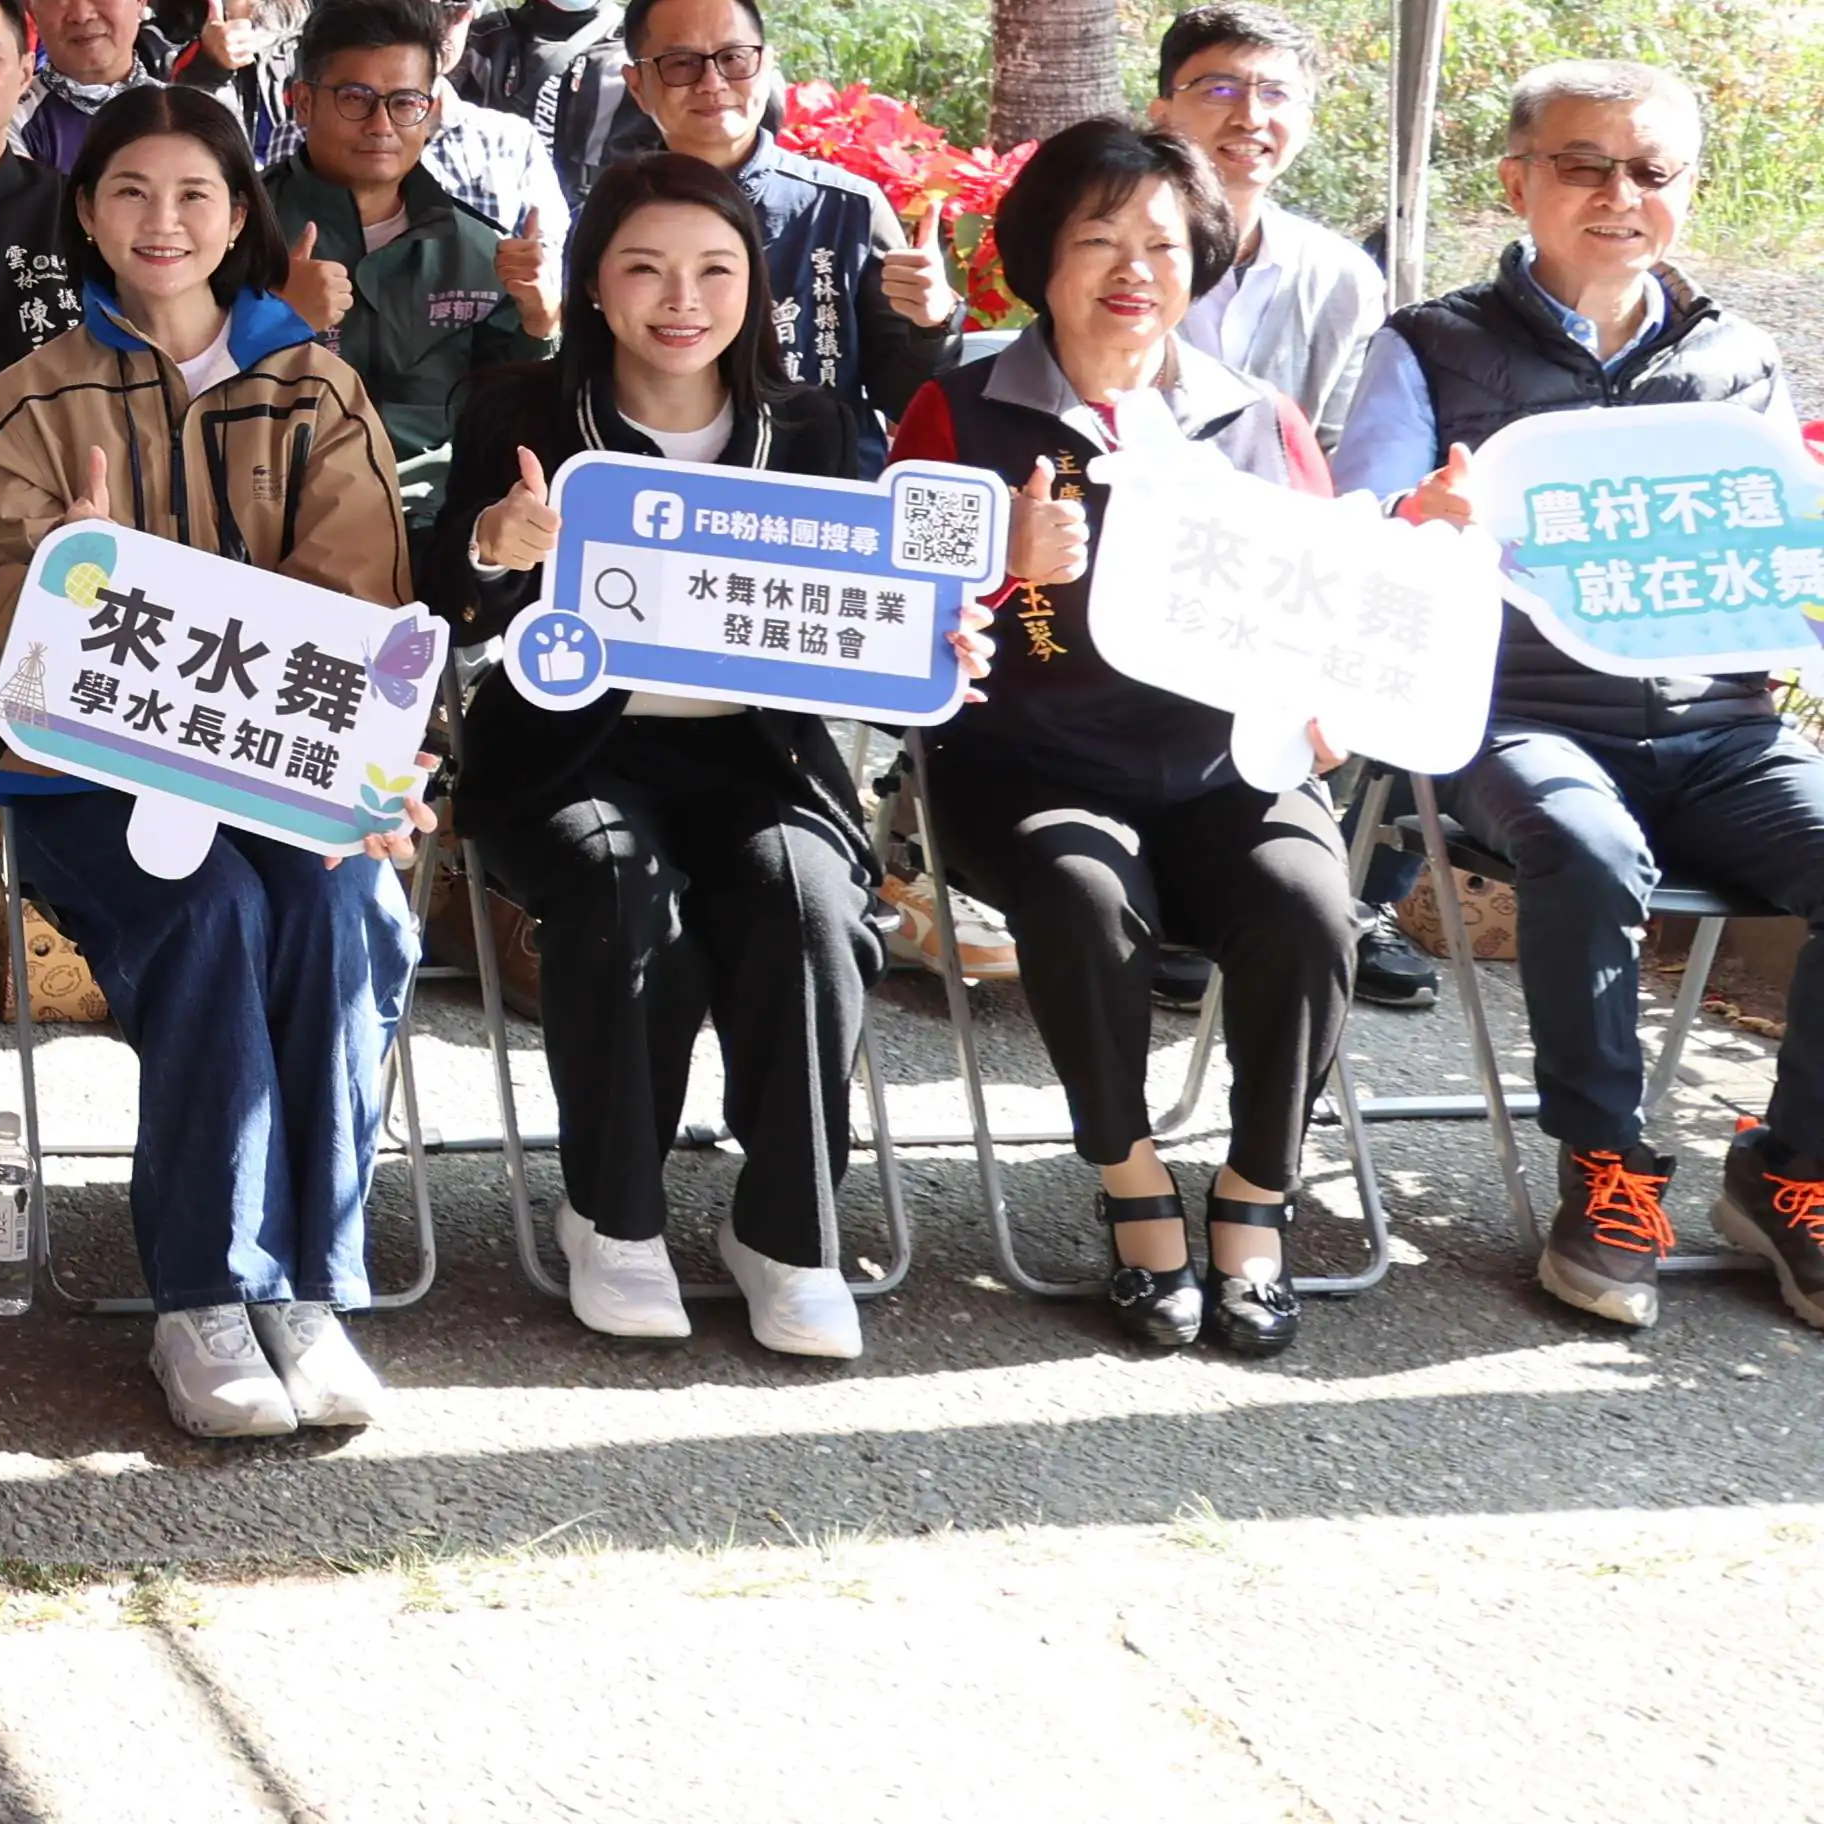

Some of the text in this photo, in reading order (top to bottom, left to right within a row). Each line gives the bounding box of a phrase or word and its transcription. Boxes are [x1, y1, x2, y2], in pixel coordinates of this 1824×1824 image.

[810, 247, 843, 388] 雲林縣議員
[694, 508, 880, 556] FB粉絲團搜尋
[1530, 474, 1785, 546] 農村不遠
[687, 569, 906, 625] 水舞休閒農業
[1170, 515, 1434, 654] 來水舞
[1574, 546, 1824, 616] 就在水舞
[80, 587, 367, 734] 來水舞
[723, 613, 866, 660] 發展協會
[69, 669, 340, 791] 學水長知識
